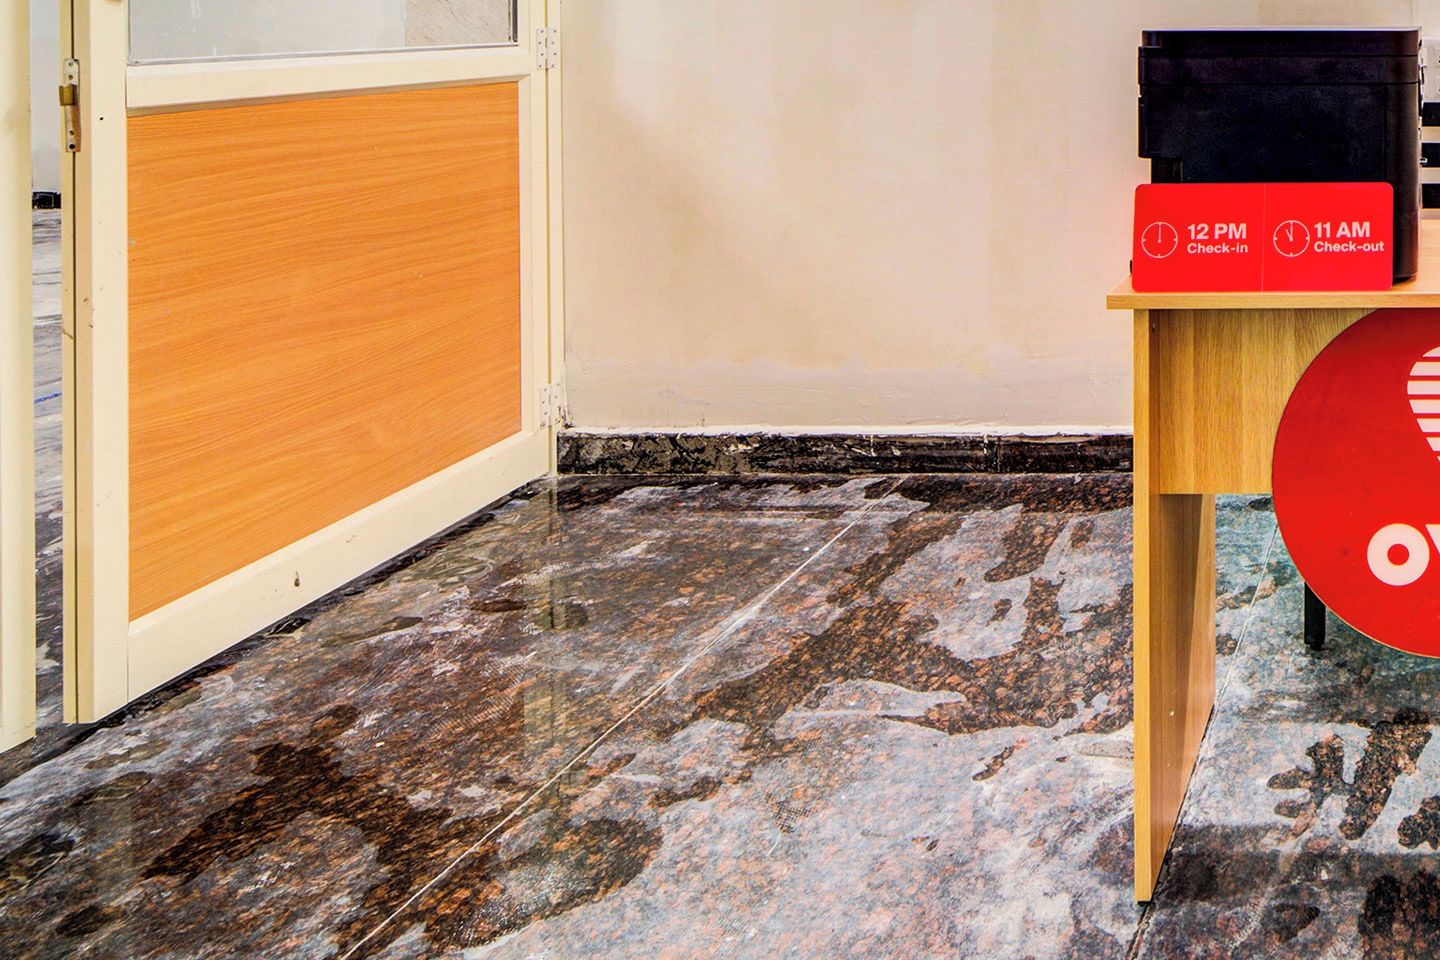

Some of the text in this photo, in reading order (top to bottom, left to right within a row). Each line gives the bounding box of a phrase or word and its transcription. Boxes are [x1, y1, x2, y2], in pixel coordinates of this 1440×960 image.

[1187, 222, 1247, 240] 12 PM
[1313, 221, 1371, 239] 11 AM
[1186, 242, 1249, 254] Check-in
[1313, 240, 1385, 253] Check-out
